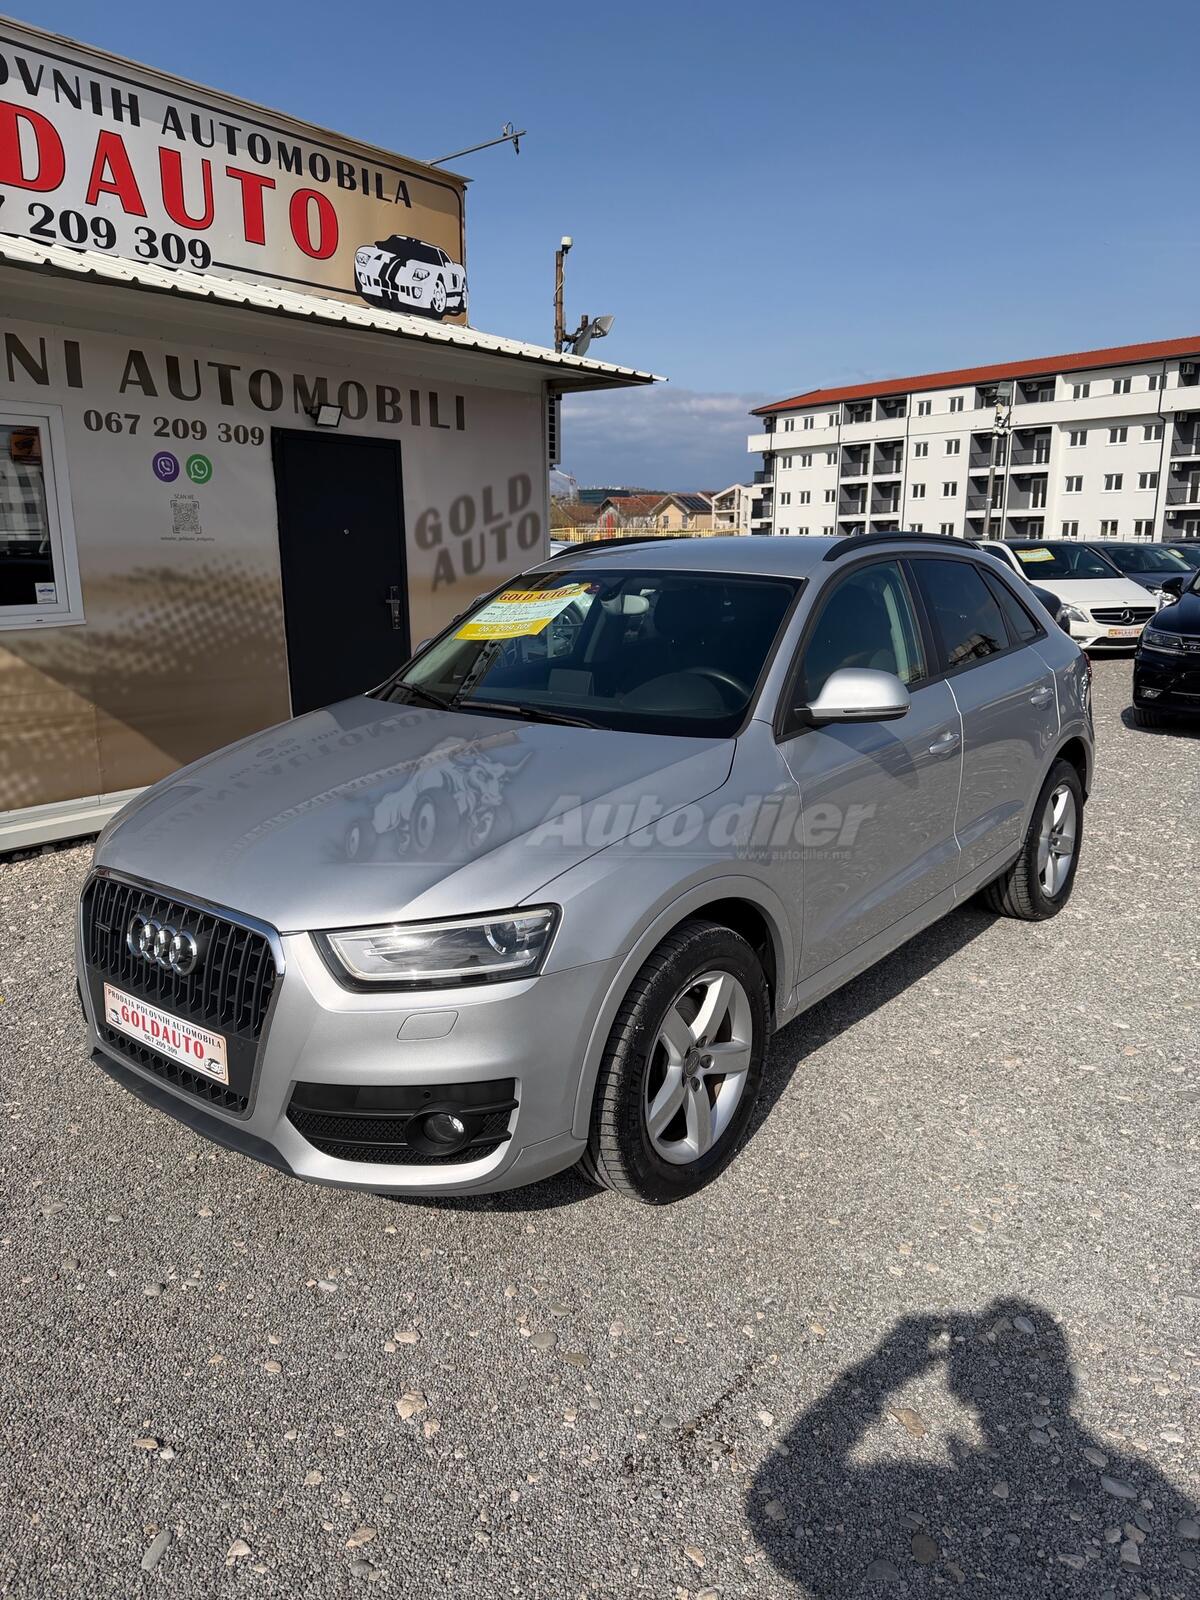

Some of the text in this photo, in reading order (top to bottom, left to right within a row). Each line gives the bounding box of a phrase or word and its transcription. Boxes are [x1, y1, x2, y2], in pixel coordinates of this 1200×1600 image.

[0, 101, 338, 260] DAUTO
[161, 105, 412, 208] AUTOMOBILA
[28, 202, 212, 270] 209 309
[4, 332, 466, 431] NI AUTOMOBILI
[83, 409, 265, 447] 067 209 309
[414, 472, 532, 550] GOLD
[431, 510, 541, 592] AUTO
[500, 593, 534, 601] GOLD
[107, 988, 222, 1049] PRODAJA POLOVNIH AUTOMOBILA
[120, 1005, 205, 1060] GOLDAUTO
